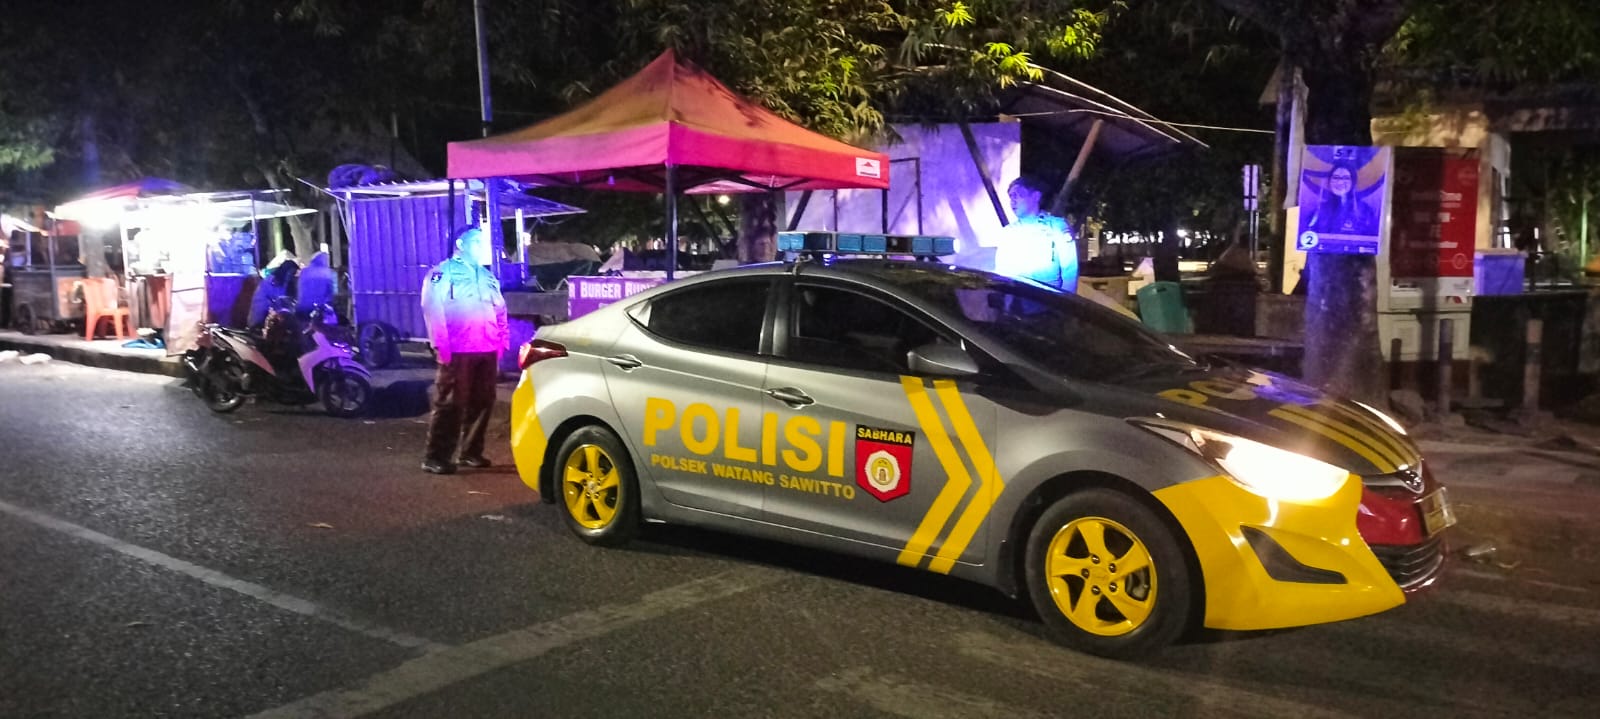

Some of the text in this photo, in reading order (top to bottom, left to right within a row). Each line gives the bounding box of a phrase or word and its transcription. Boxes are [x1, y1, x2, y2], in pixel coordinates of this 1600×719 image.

[580, 281, 622, 299] BURGER
[643, 397, 847, 478] POLISI
[857, 427, 913, 445] SABHARA
[651, 453, 856, 500] POLSEK WATANG SAWITTO
